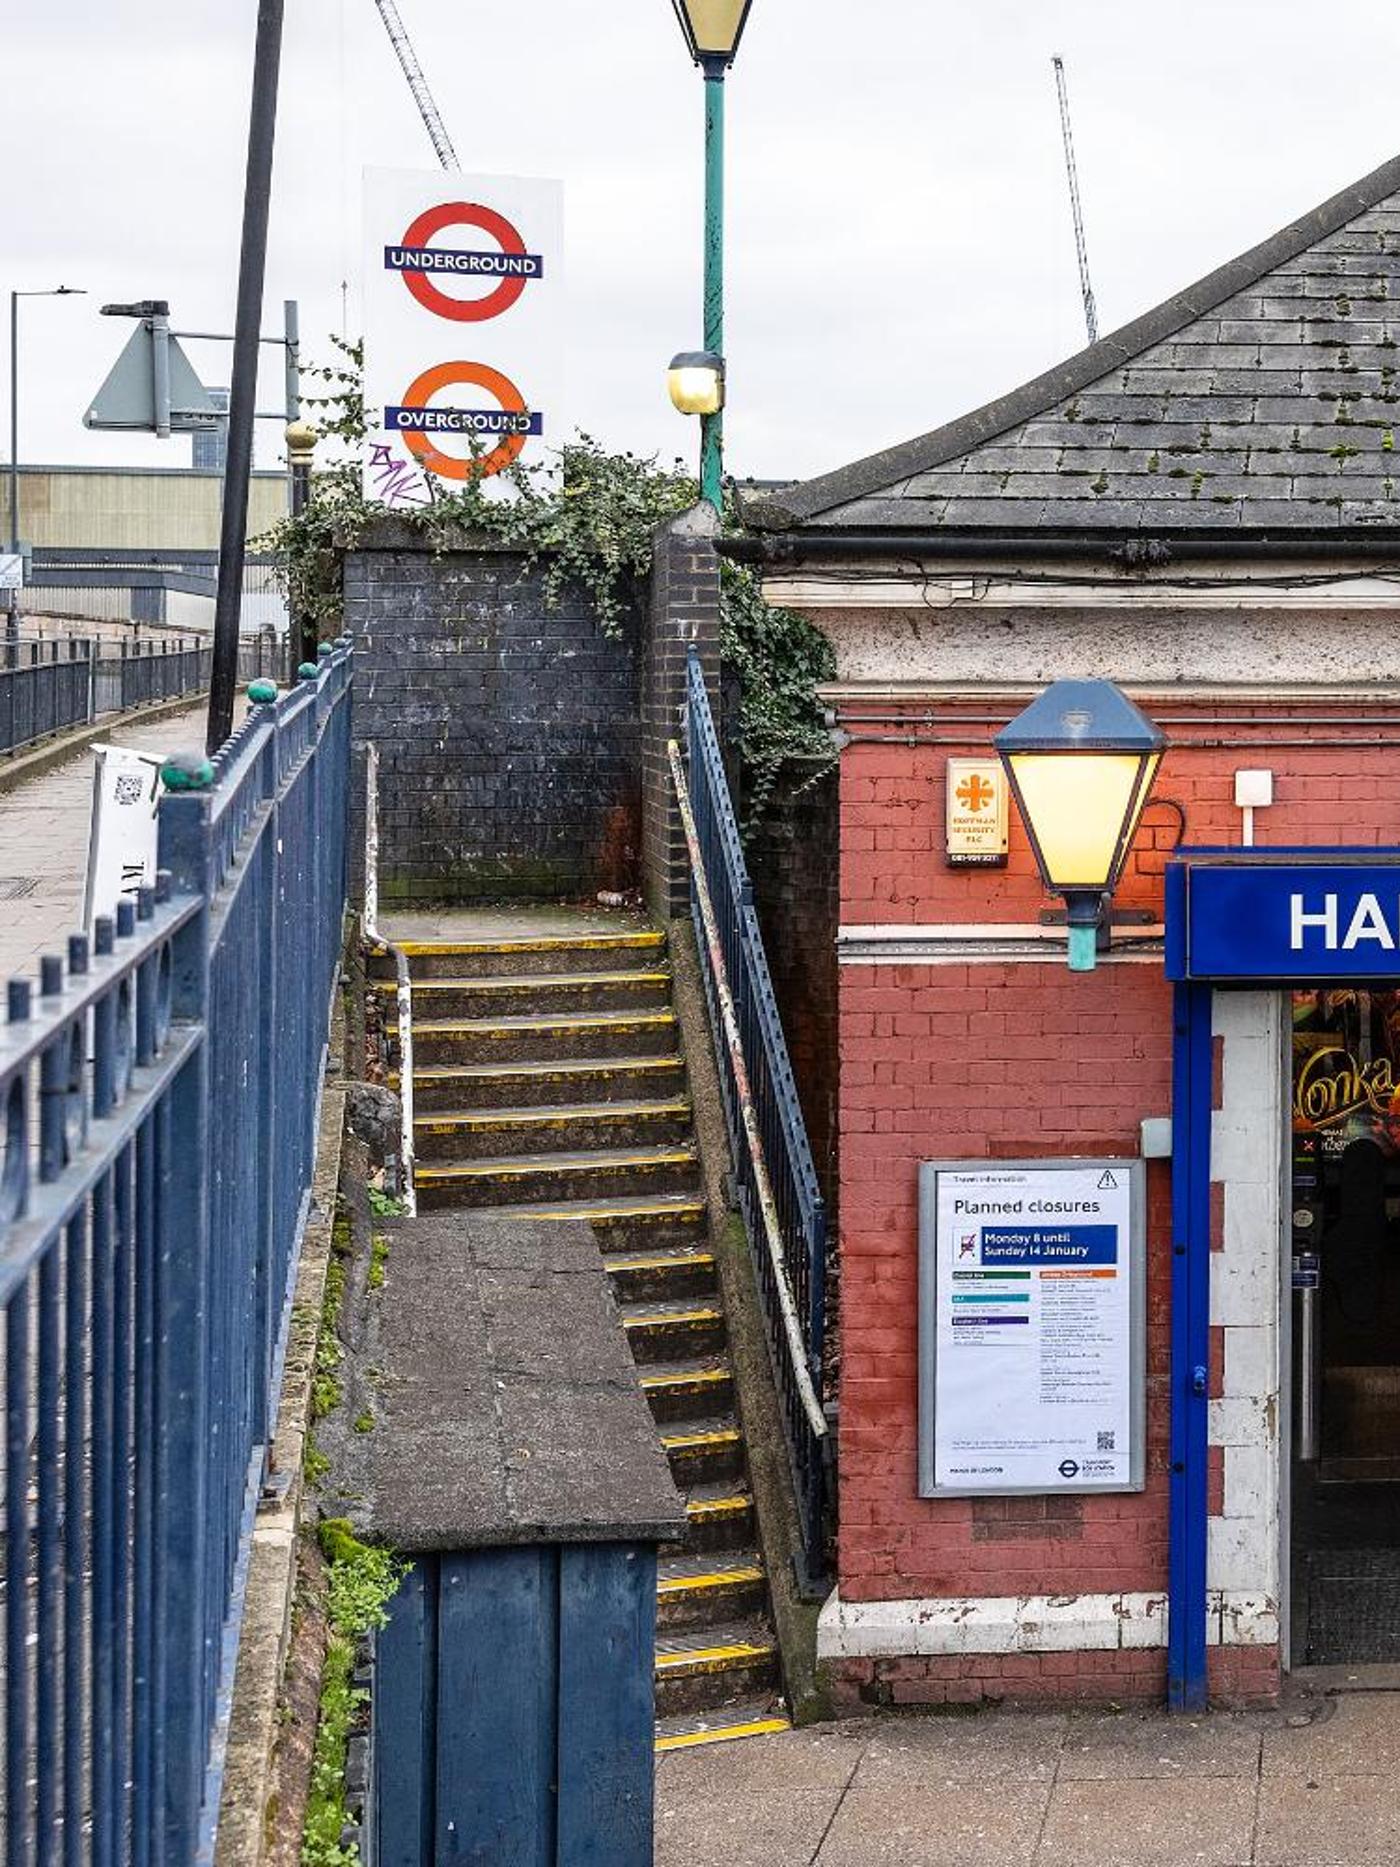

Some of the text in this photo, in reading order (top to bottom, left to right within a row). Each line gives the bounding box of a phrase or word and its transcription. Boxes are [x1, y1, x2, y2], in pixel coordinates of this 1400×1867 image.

[391, 251, 537, 274] UNDERGROUND
[397, 411, 531, 431] OVERGROUND
[955, 1200, 1100, 1214] Planned closures
[985, 1232, 1071, 1246] Monday 8 until
[984, 1246, 1090, 1258] Sunday 14 January
